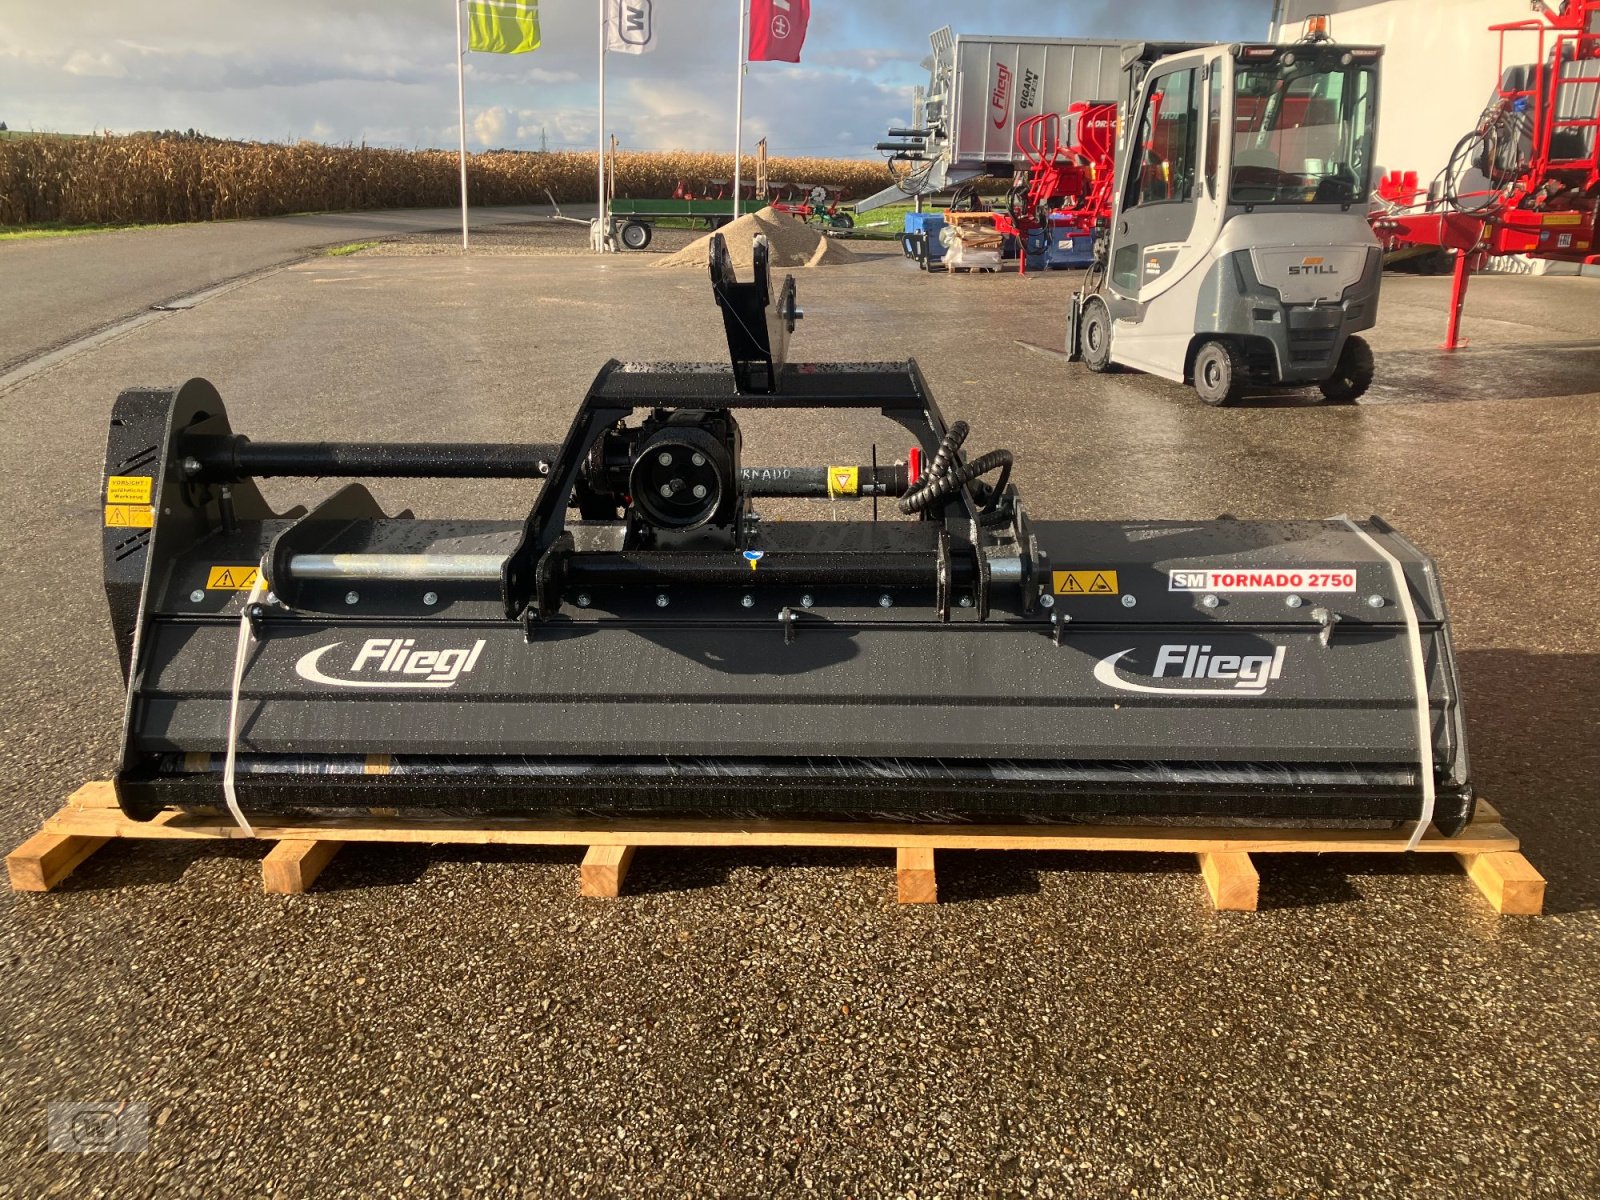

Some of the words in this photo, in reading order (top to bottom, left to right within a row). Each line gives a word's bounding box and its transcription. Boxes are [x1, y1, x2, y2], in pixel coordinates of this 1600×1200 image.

[992, 62, 1012, 110] Fliegl
[1019, 67, 1034, 109] GIGANT
[1288, 264, 1339, 275] STILL
[1174, 574, 1204, 588] SM
[1211, 574, 1303, 587] TORNADO
[1308, 574, 1354, 587] 2750
[350, 638, 487, 681] Fliegl
[1152, 644, 1287, 688] Fliegl
